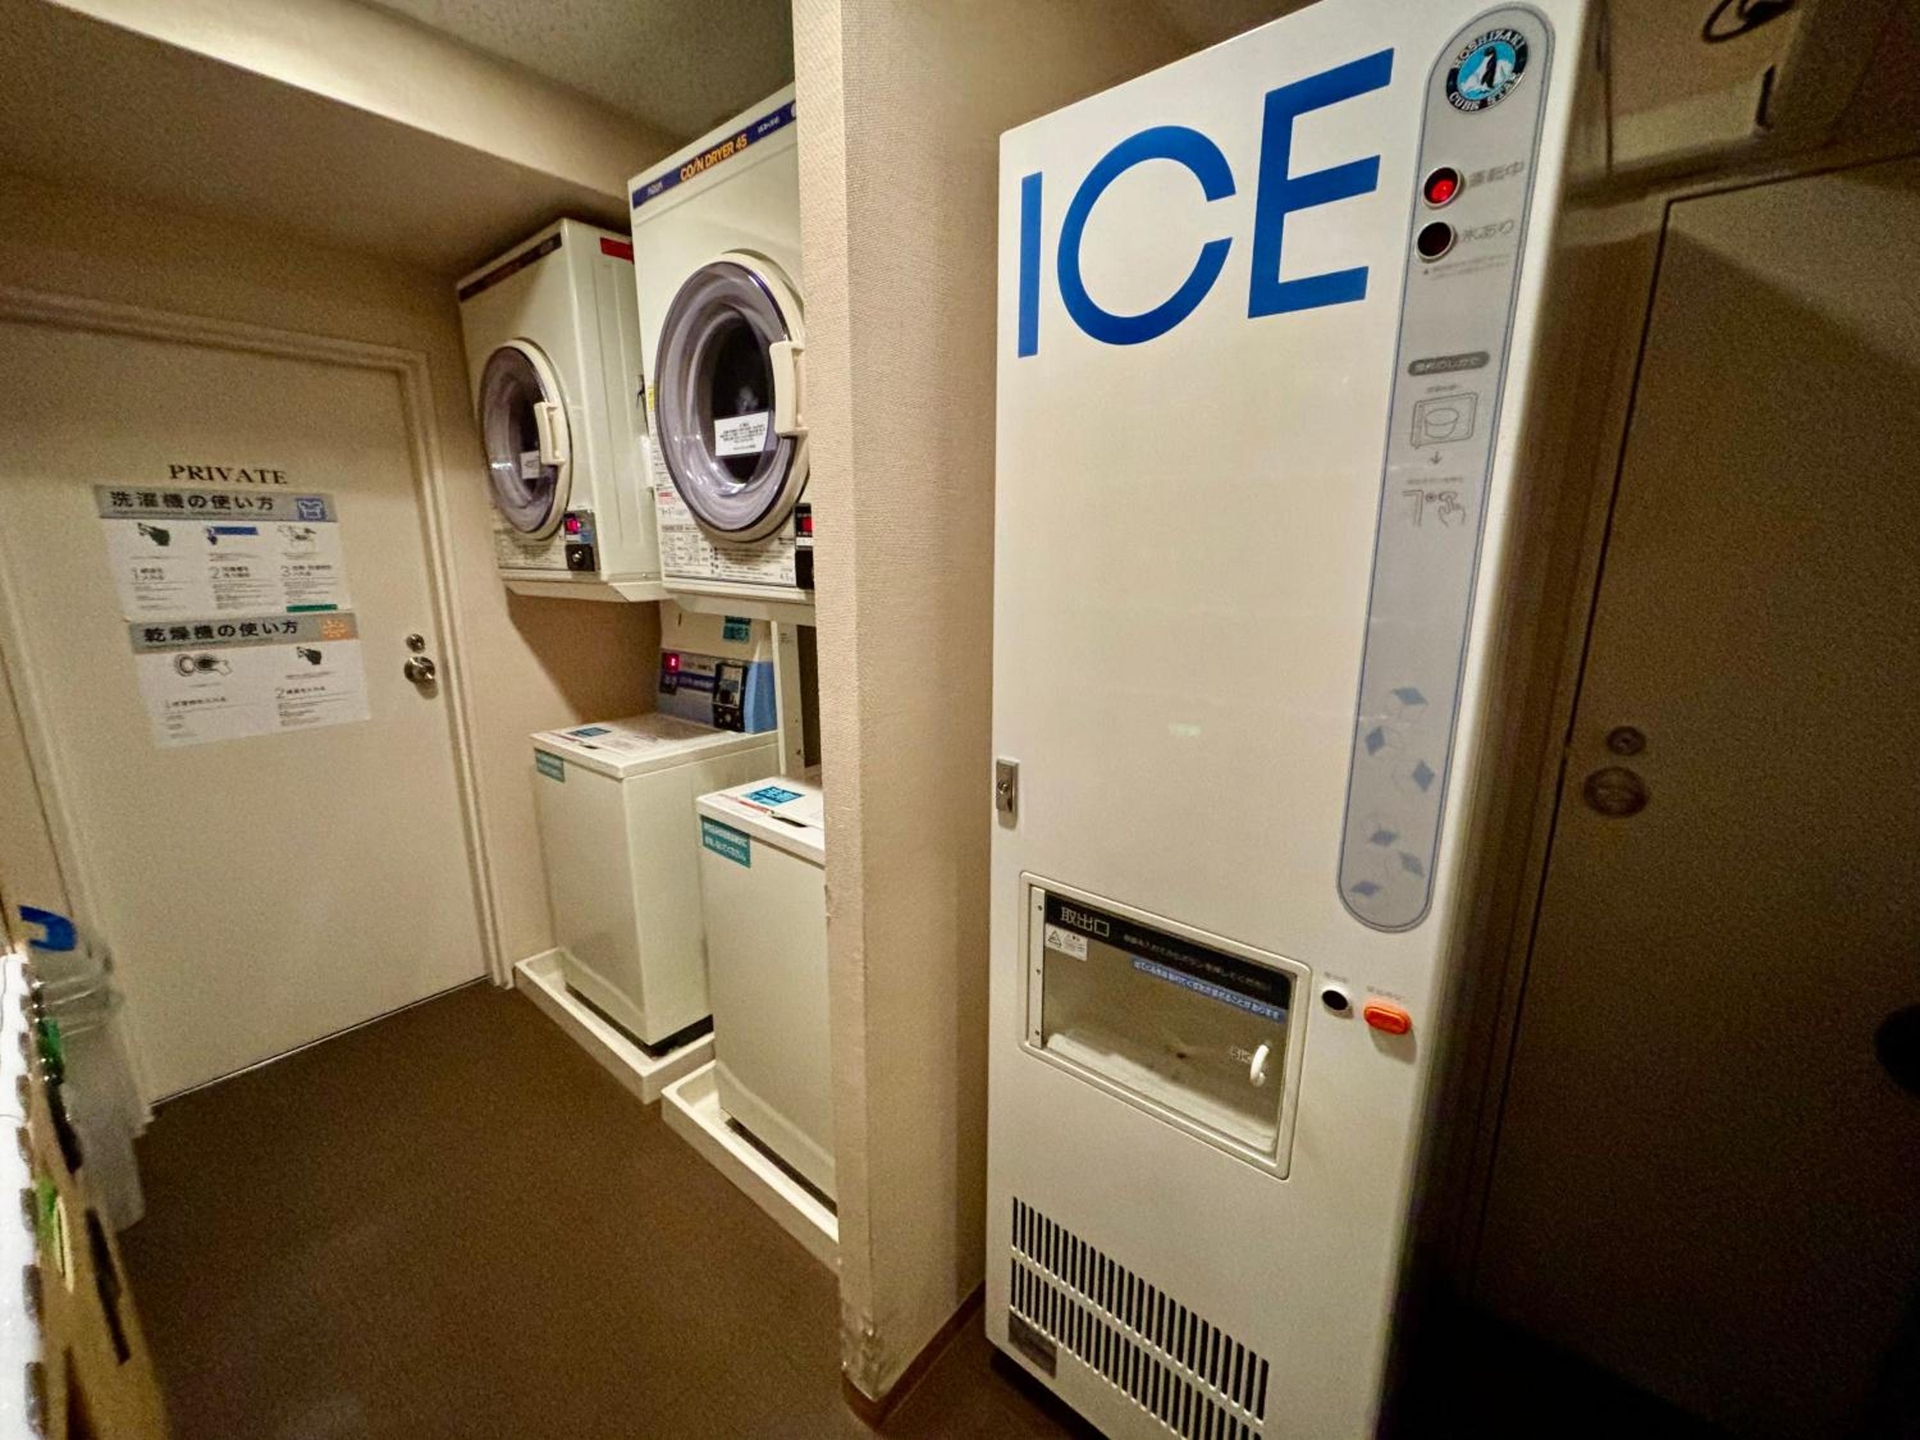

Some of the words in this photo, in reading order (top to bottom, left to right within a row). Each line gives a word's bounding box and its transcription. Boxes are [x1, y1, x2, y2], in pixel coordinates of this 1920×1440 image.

[704, 141, 734, 169] DRYER
[735, 133, 748, 150] 45
[1017, 48, 1394, 358] ICE
[168, 464, 288, 485] PRIVATE
[110, 491, 274, 511] 洗濯機の使い方
[143, 620, 300, 643] 乾燥機の使い方
[1060, 906, 1110, 938] 取出口
